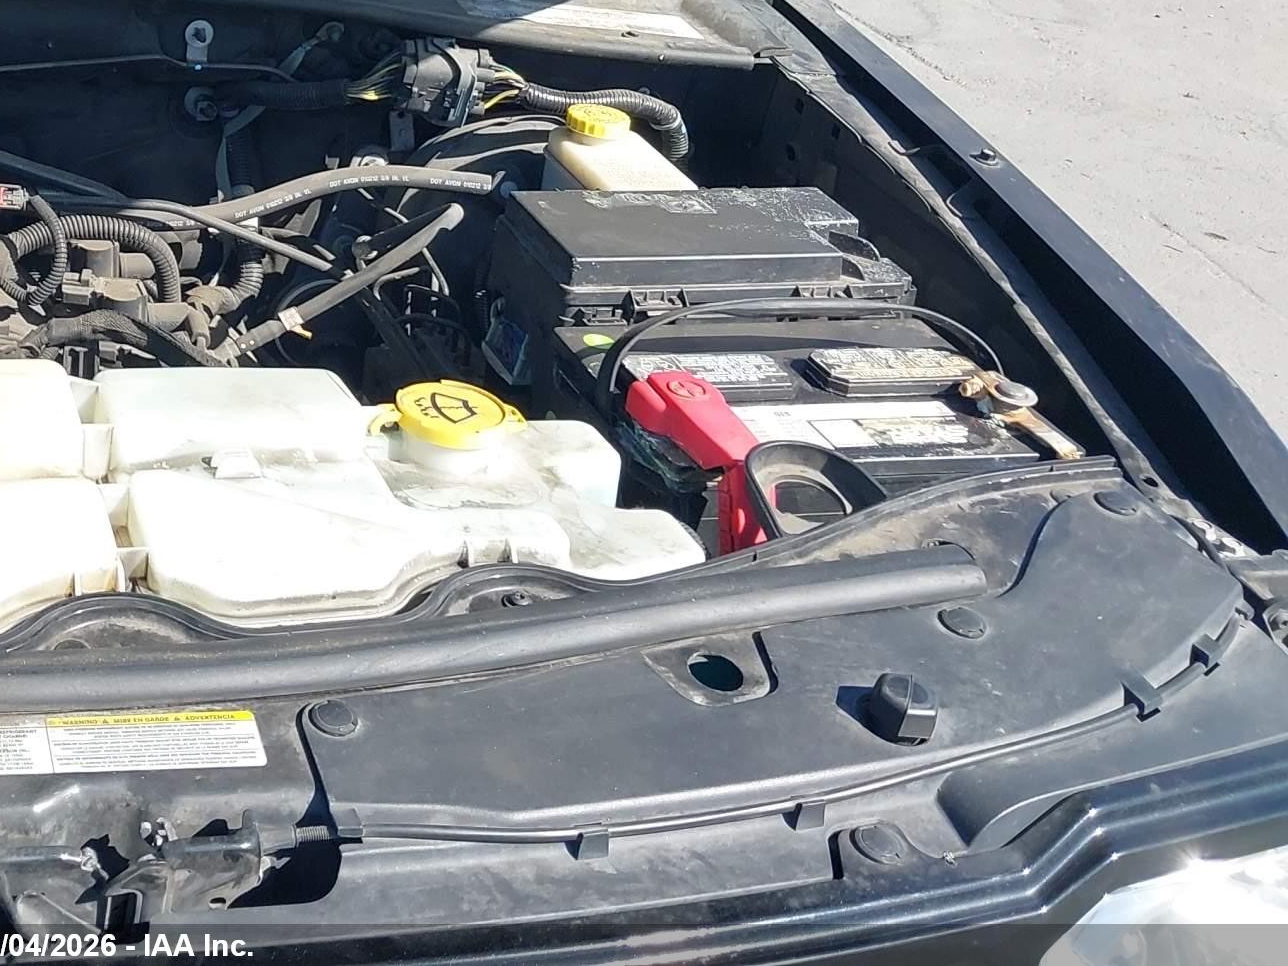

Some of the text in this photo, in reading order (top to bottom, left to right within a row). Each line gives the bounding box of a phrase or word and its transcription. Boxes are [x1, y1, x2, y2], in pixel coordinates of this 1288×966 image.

[329, 179, 341, 188] DOT
[343, 177, 359, 185] AVON
[429, 177, 443, 185] DOT
[445, 178, 462, 187] AVON
[234, 209, 248, 219] DOT
[185, 713, 236, 722] ADVERTENCIA
